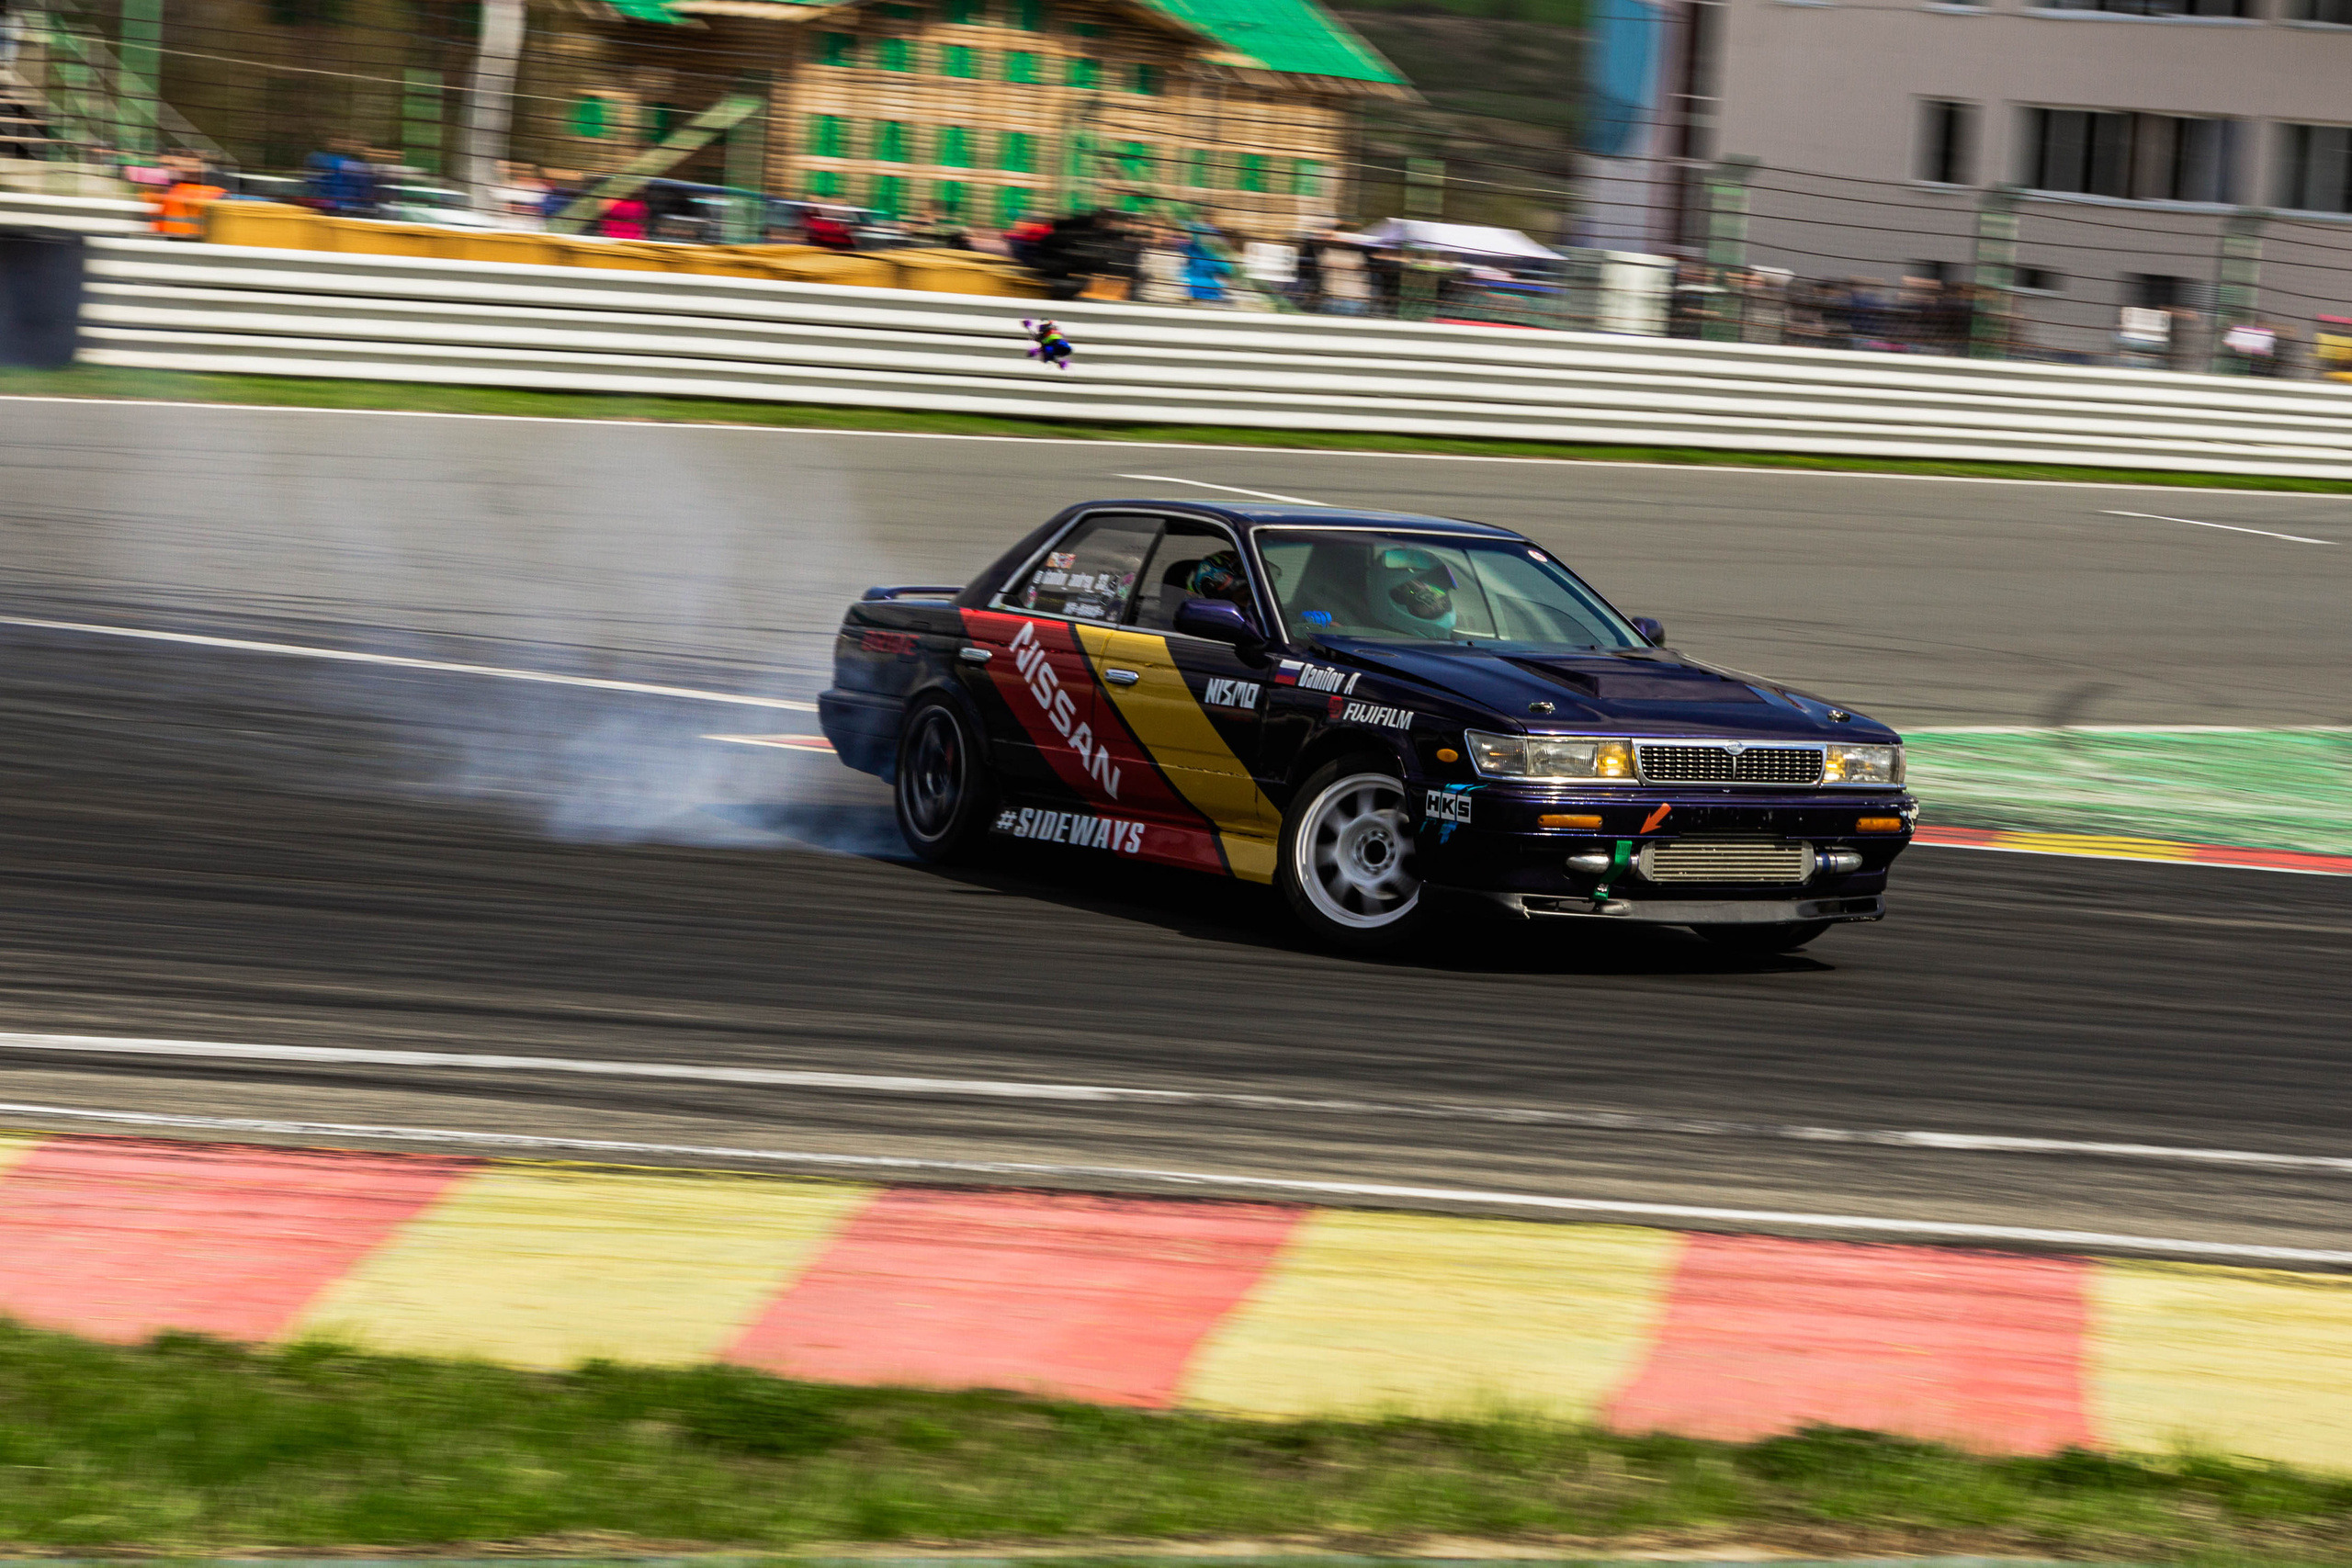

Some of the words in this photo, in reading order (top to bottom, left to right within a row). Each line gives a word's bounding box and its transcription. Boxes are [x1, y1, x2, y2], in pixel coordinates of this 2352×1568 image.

[1204, 678, 1261, 709] NISMO
[1343, 672, 1362, 695] A
[1009, 621, 1121, 799] NISSAN
[1342, 703, 1414, 730] FUJIFILM
[1427, 793, 1470, 819] HKS
[997, 807, 1145, 853] #SIDEWAYS
